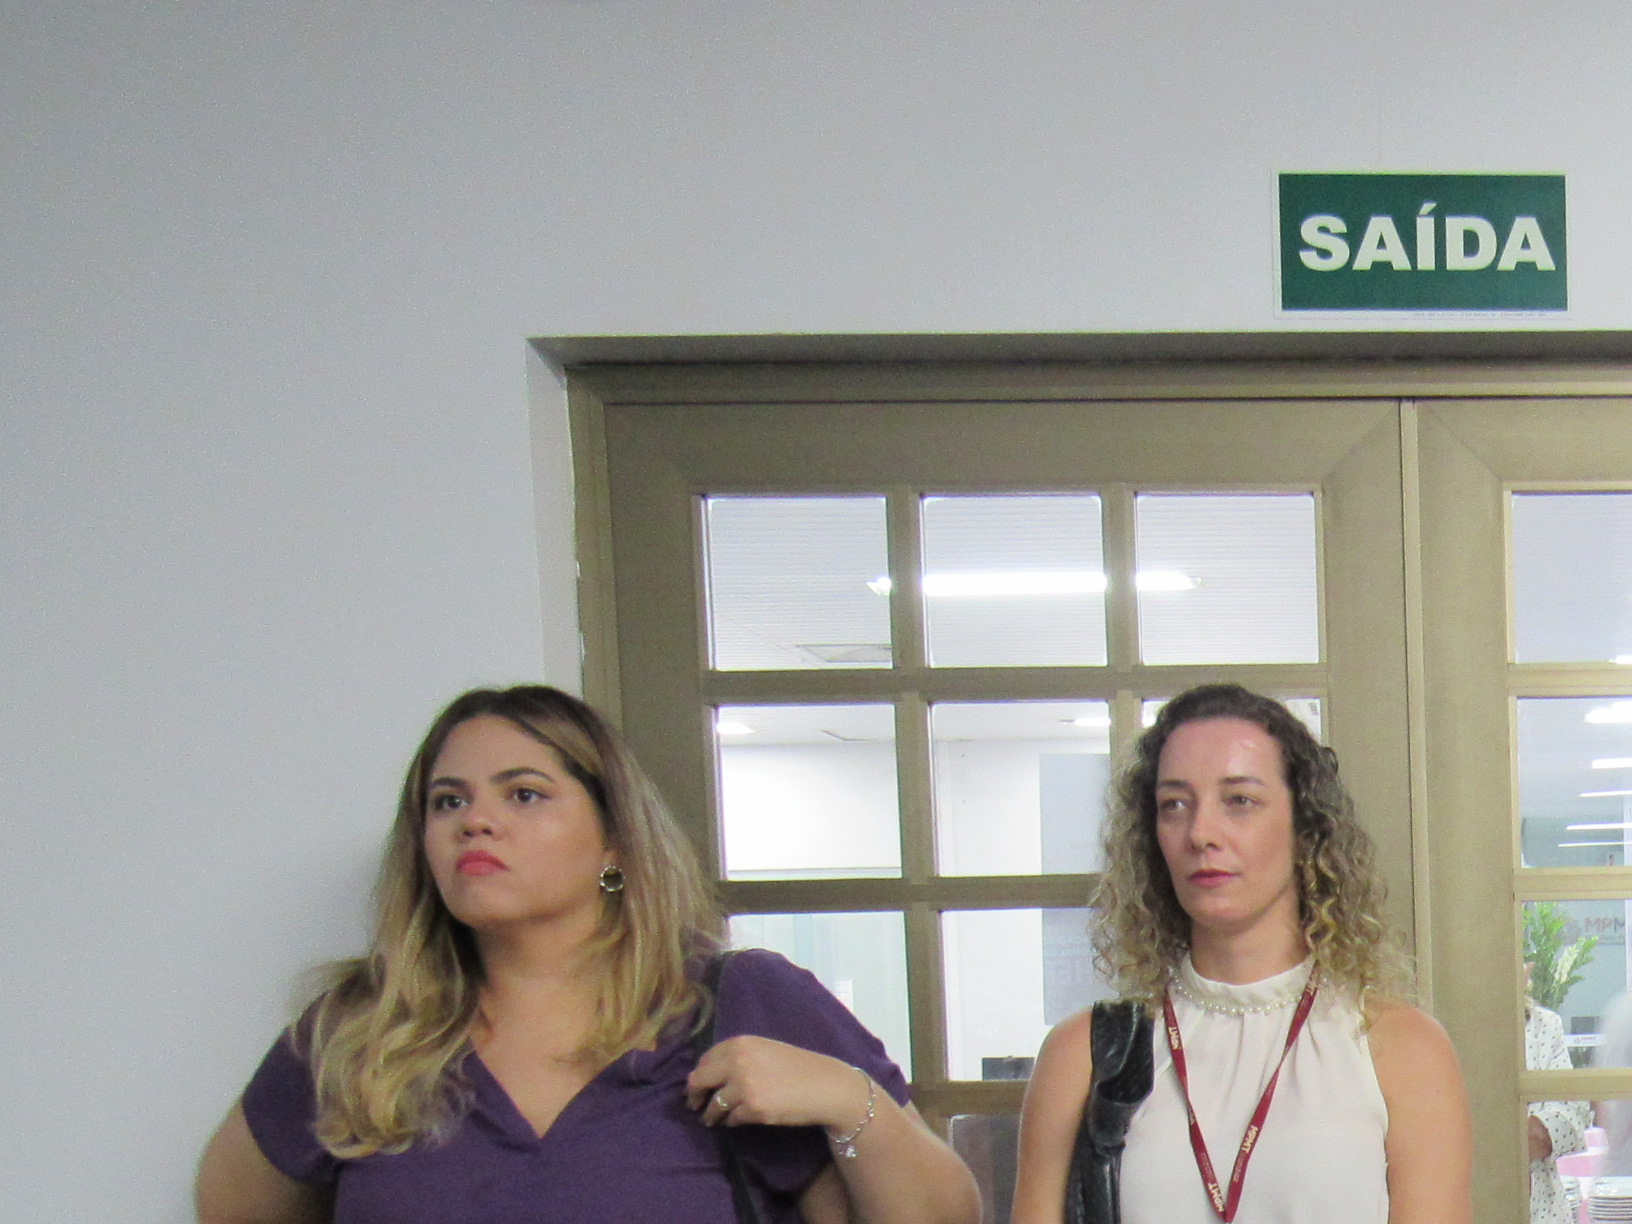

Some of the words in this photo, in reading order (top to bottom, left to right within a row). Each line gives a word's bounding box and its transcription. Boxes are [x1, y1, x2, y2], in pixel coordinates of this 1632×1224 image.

[1298, 200, 1557, 272] SAÍDA
[1242, 1125, 1258, 1154] MPMT
[1208, 1182, 1224, 1212] MPMT
